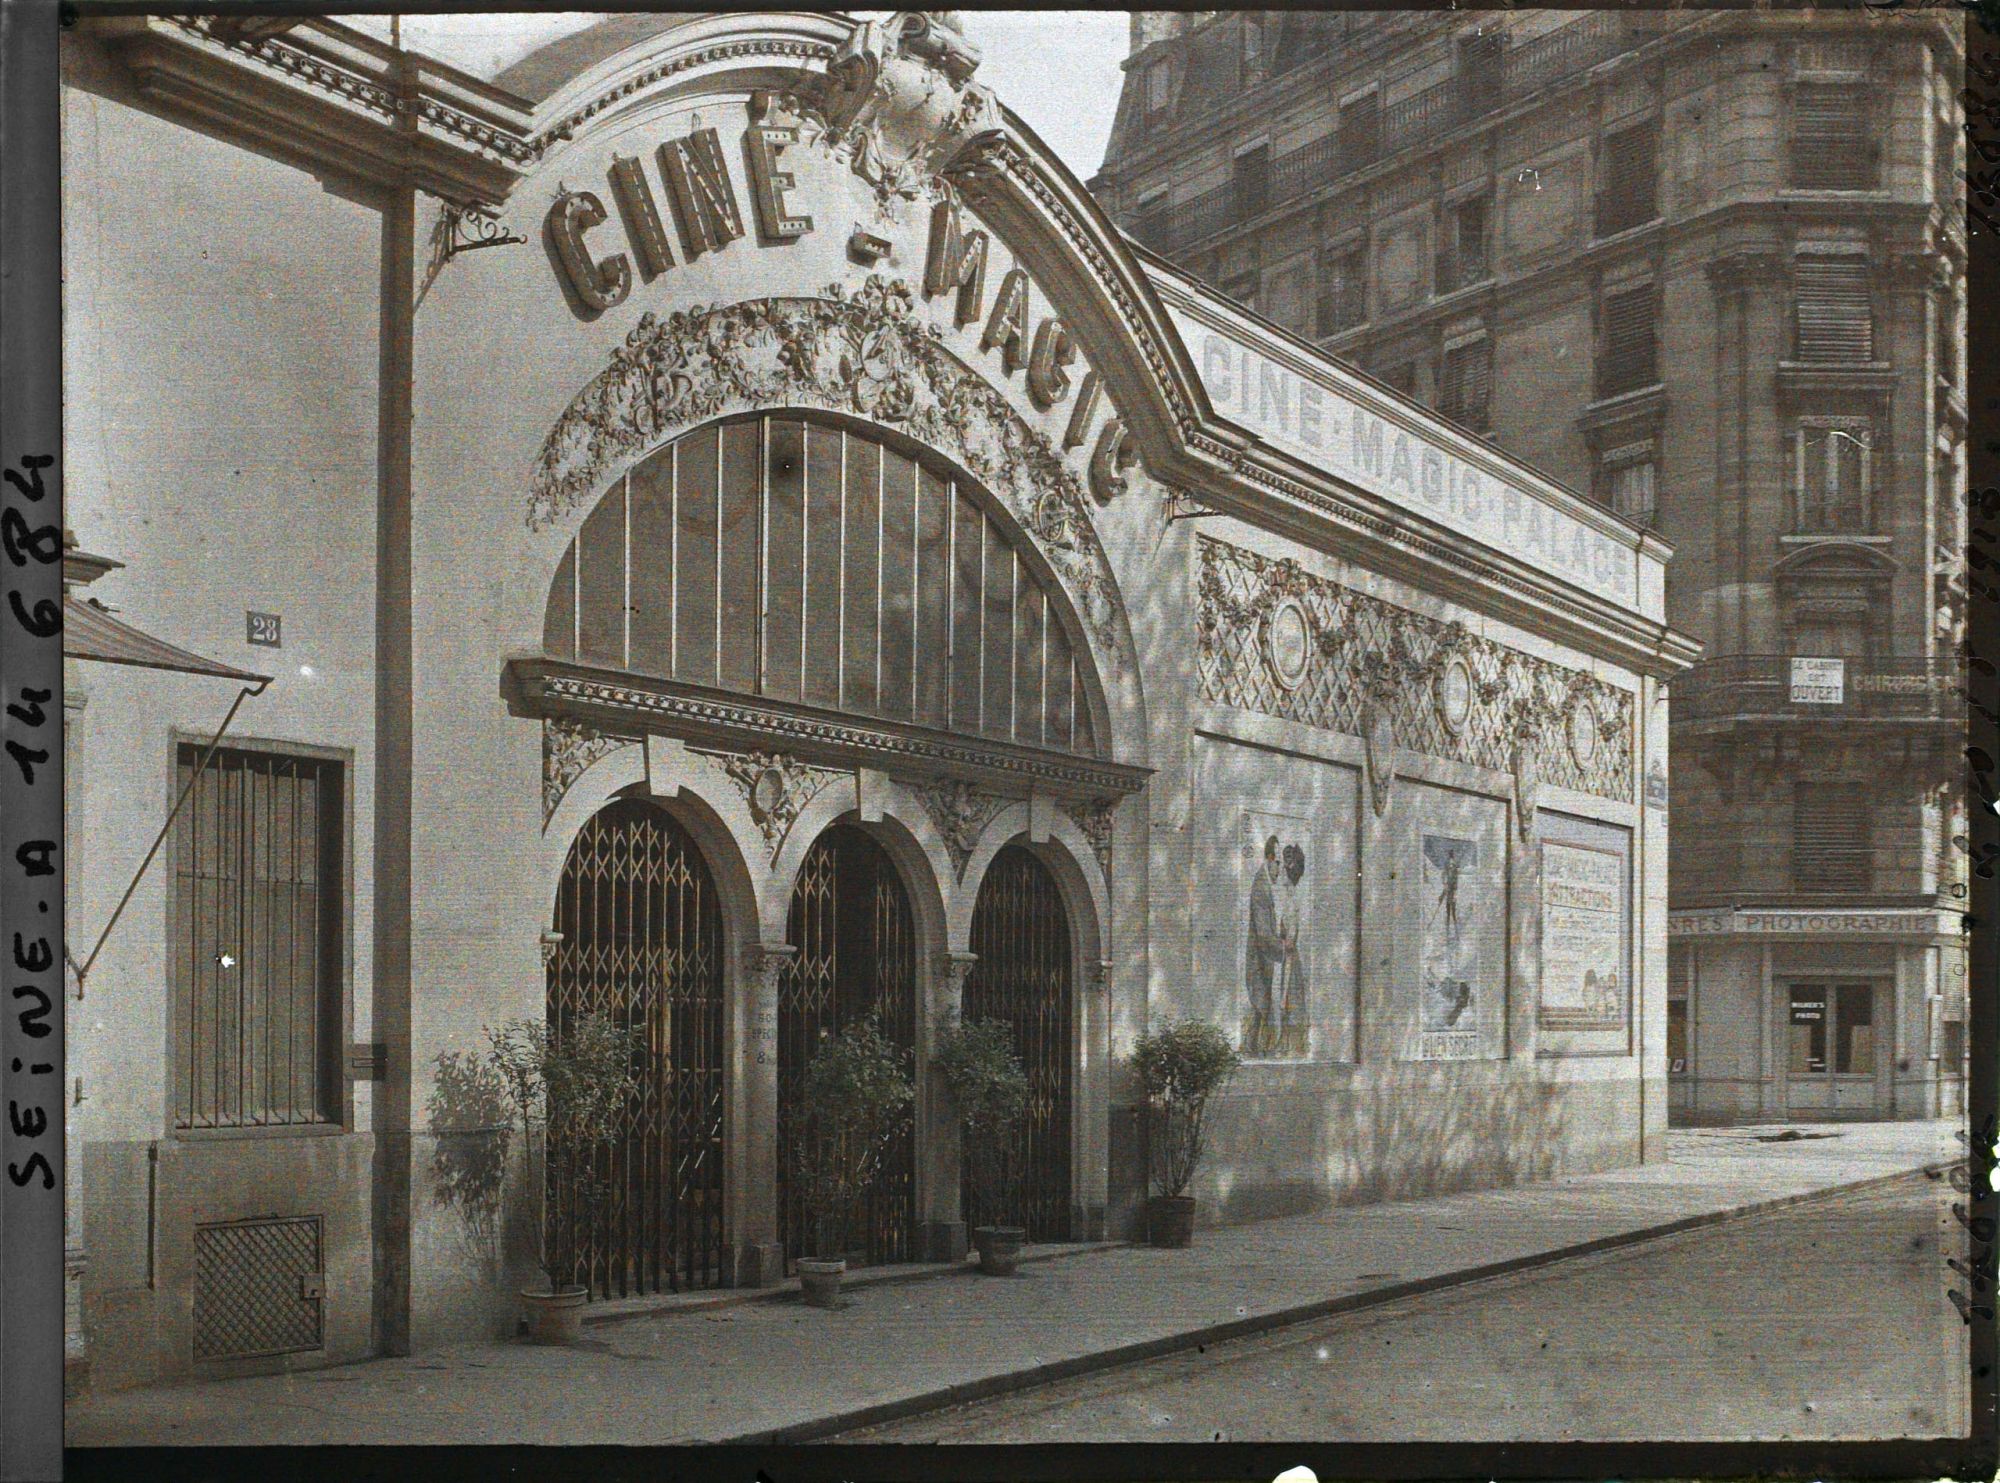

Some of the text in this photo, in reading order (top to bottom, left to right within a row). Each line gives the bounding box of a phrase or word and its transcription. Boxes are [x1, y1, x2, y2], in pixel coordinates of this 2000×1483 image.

[546, 126, 814, 312] CINE
[926, 200, 1139, 503] MAGIC
[252, 616, 278, 642] 28
[1792, 684, 1840, 701] OUVERT
[1746, 914, 1926, 932] PHOTOGRAPHIE
